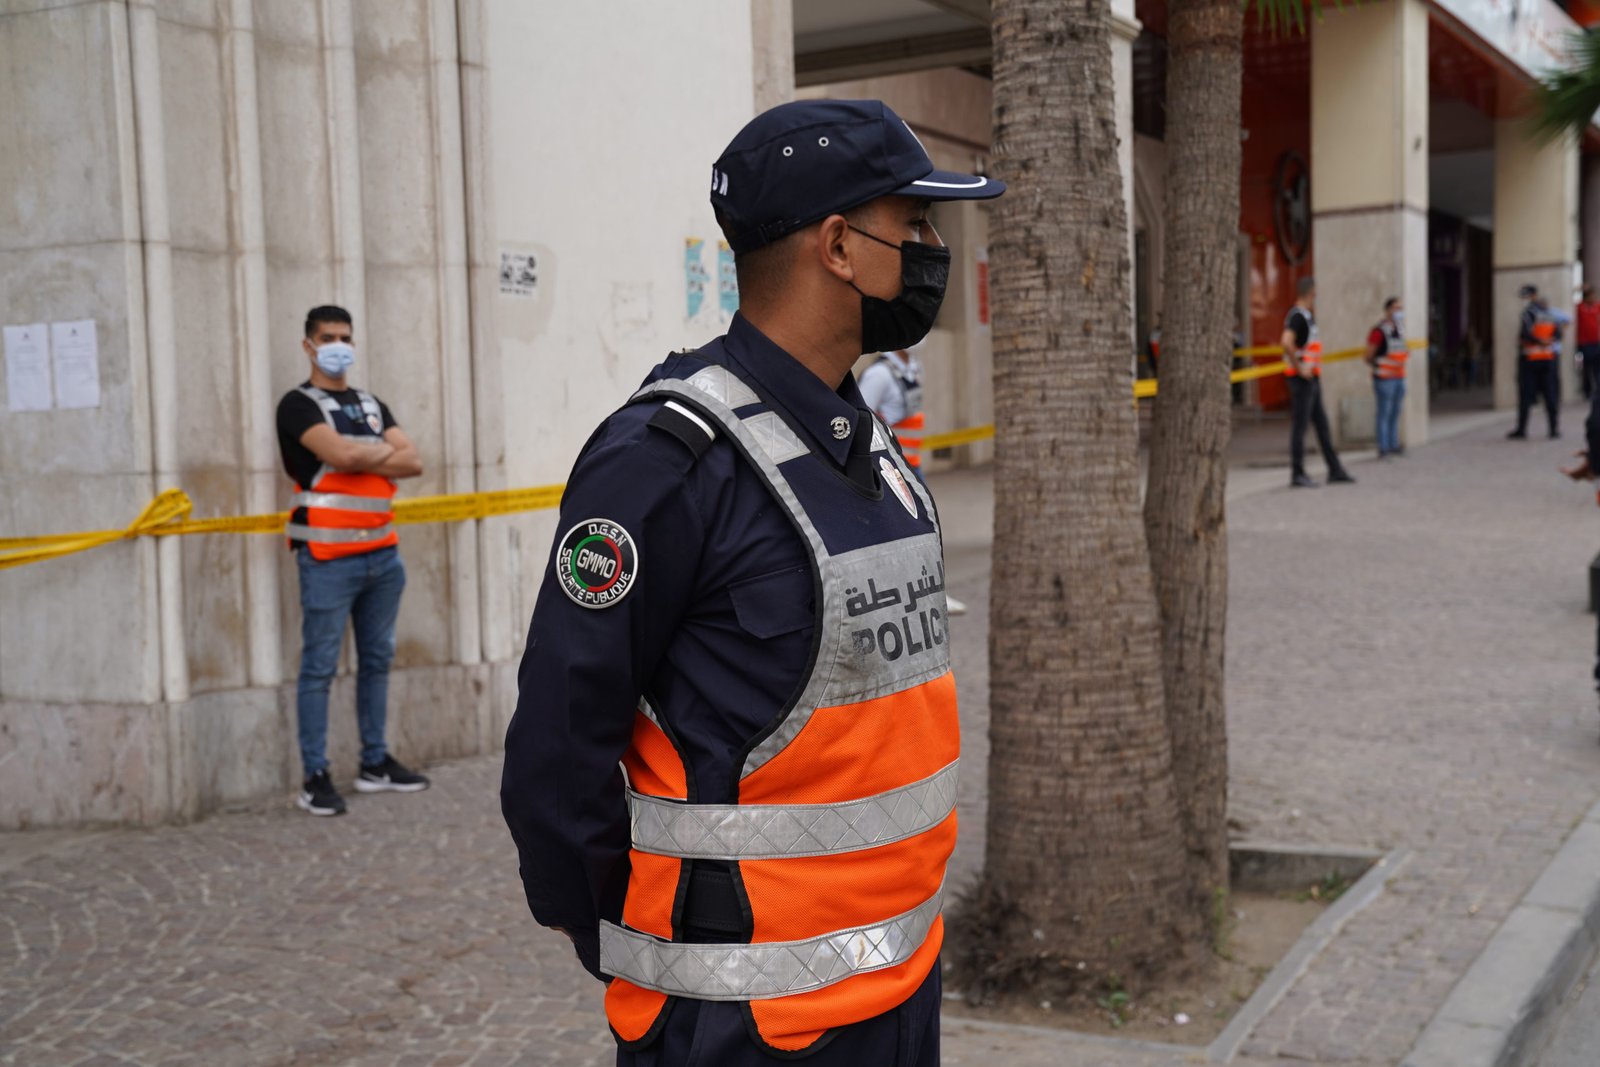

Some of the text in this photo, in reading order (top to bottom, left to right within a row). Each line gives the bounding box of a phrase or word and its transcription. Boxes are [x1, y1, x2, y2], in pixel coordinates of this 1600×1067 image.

[576, 548, 616, 579] GMMO
[585, 571, 631, 604] PUBLIQUE
[845, 561, 945, 617] لشرطة
[851, 607, 948, 662] POLIC
